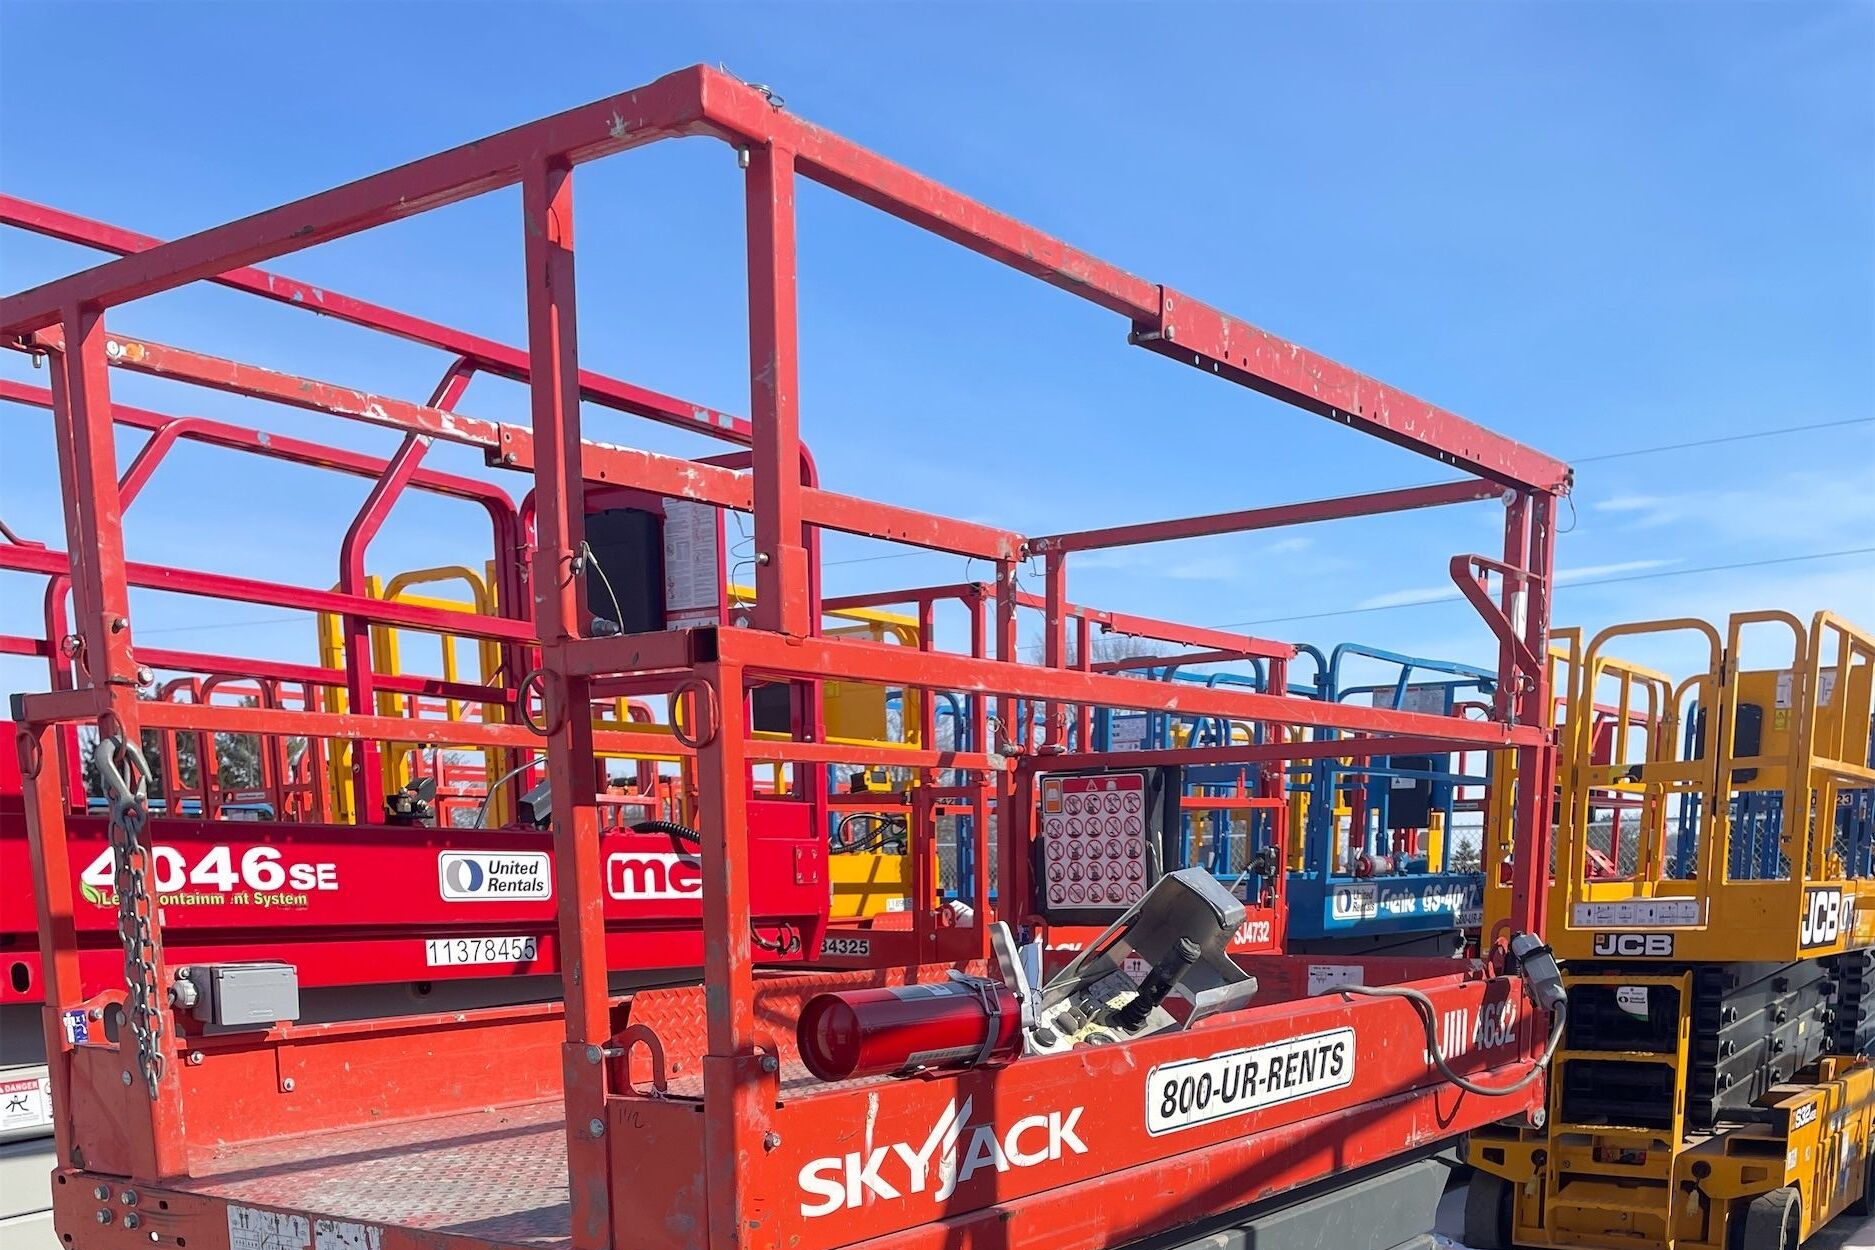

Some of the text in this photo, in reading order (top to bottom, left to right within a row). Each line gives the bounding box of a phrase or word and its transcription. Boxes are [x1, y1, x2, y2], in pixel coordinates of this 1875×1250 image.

[488, 860, 538, 875] United
[487, 877, 544, 892] Rentals
[157, 889, 249, 906] ontainmnt
[254, 890, 307, 908] System
[1380, 886, 1415, 913] Genie
[1802, 890, 1841, 947] JCB
[429, 937, 536, 963] 11378455
[1594, 934, 1673, 957] JCB
[4, 1080, 39, 1094] DANGER
[1160, 1040, 1346, 1119] 800-UR-RENTS
[798, 1092, 1089, 1218] SKYJACK
